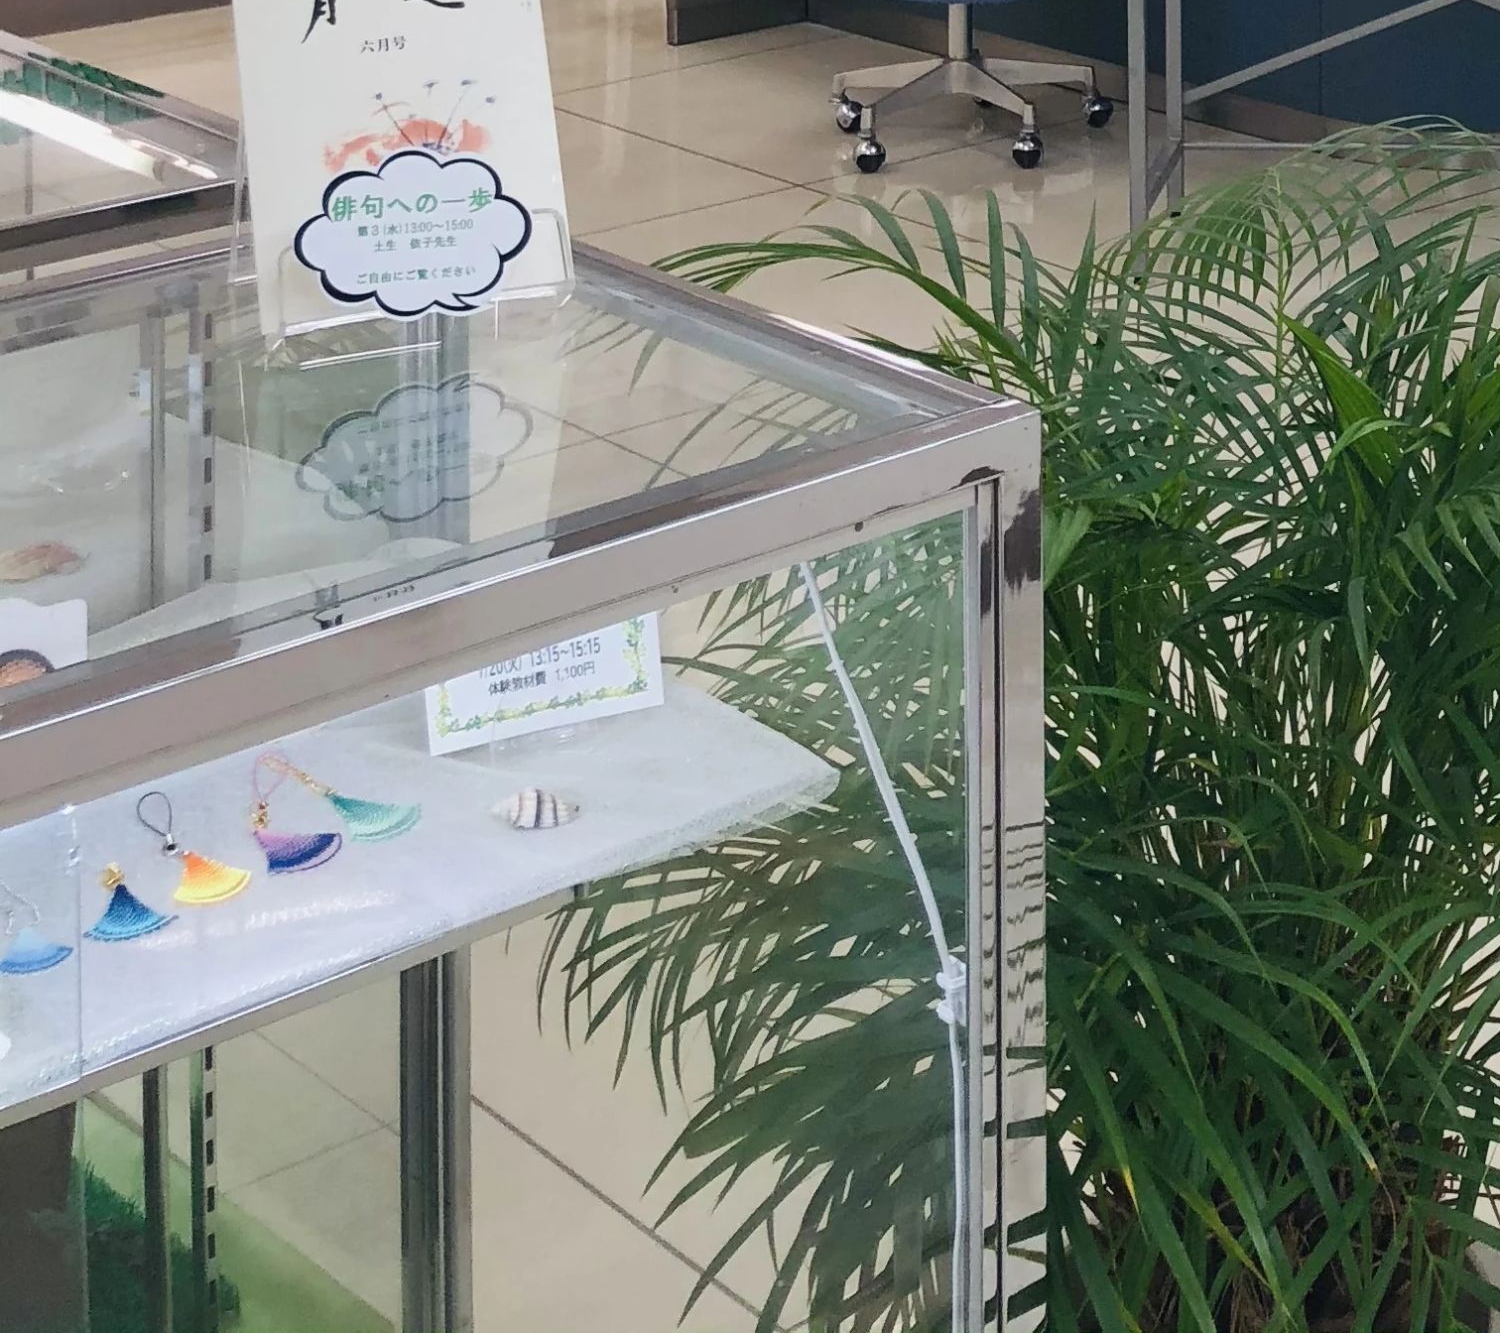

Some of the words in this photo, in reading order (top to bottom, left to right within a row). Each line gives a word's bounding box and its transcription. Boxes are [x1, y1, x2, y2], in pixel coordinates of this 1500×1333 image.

[359, 35, 408, 54] 六月号
[331, 186, 493, 222] 俳句への一歩
[356, 266, 476, 285] ご自由にご覧ください
